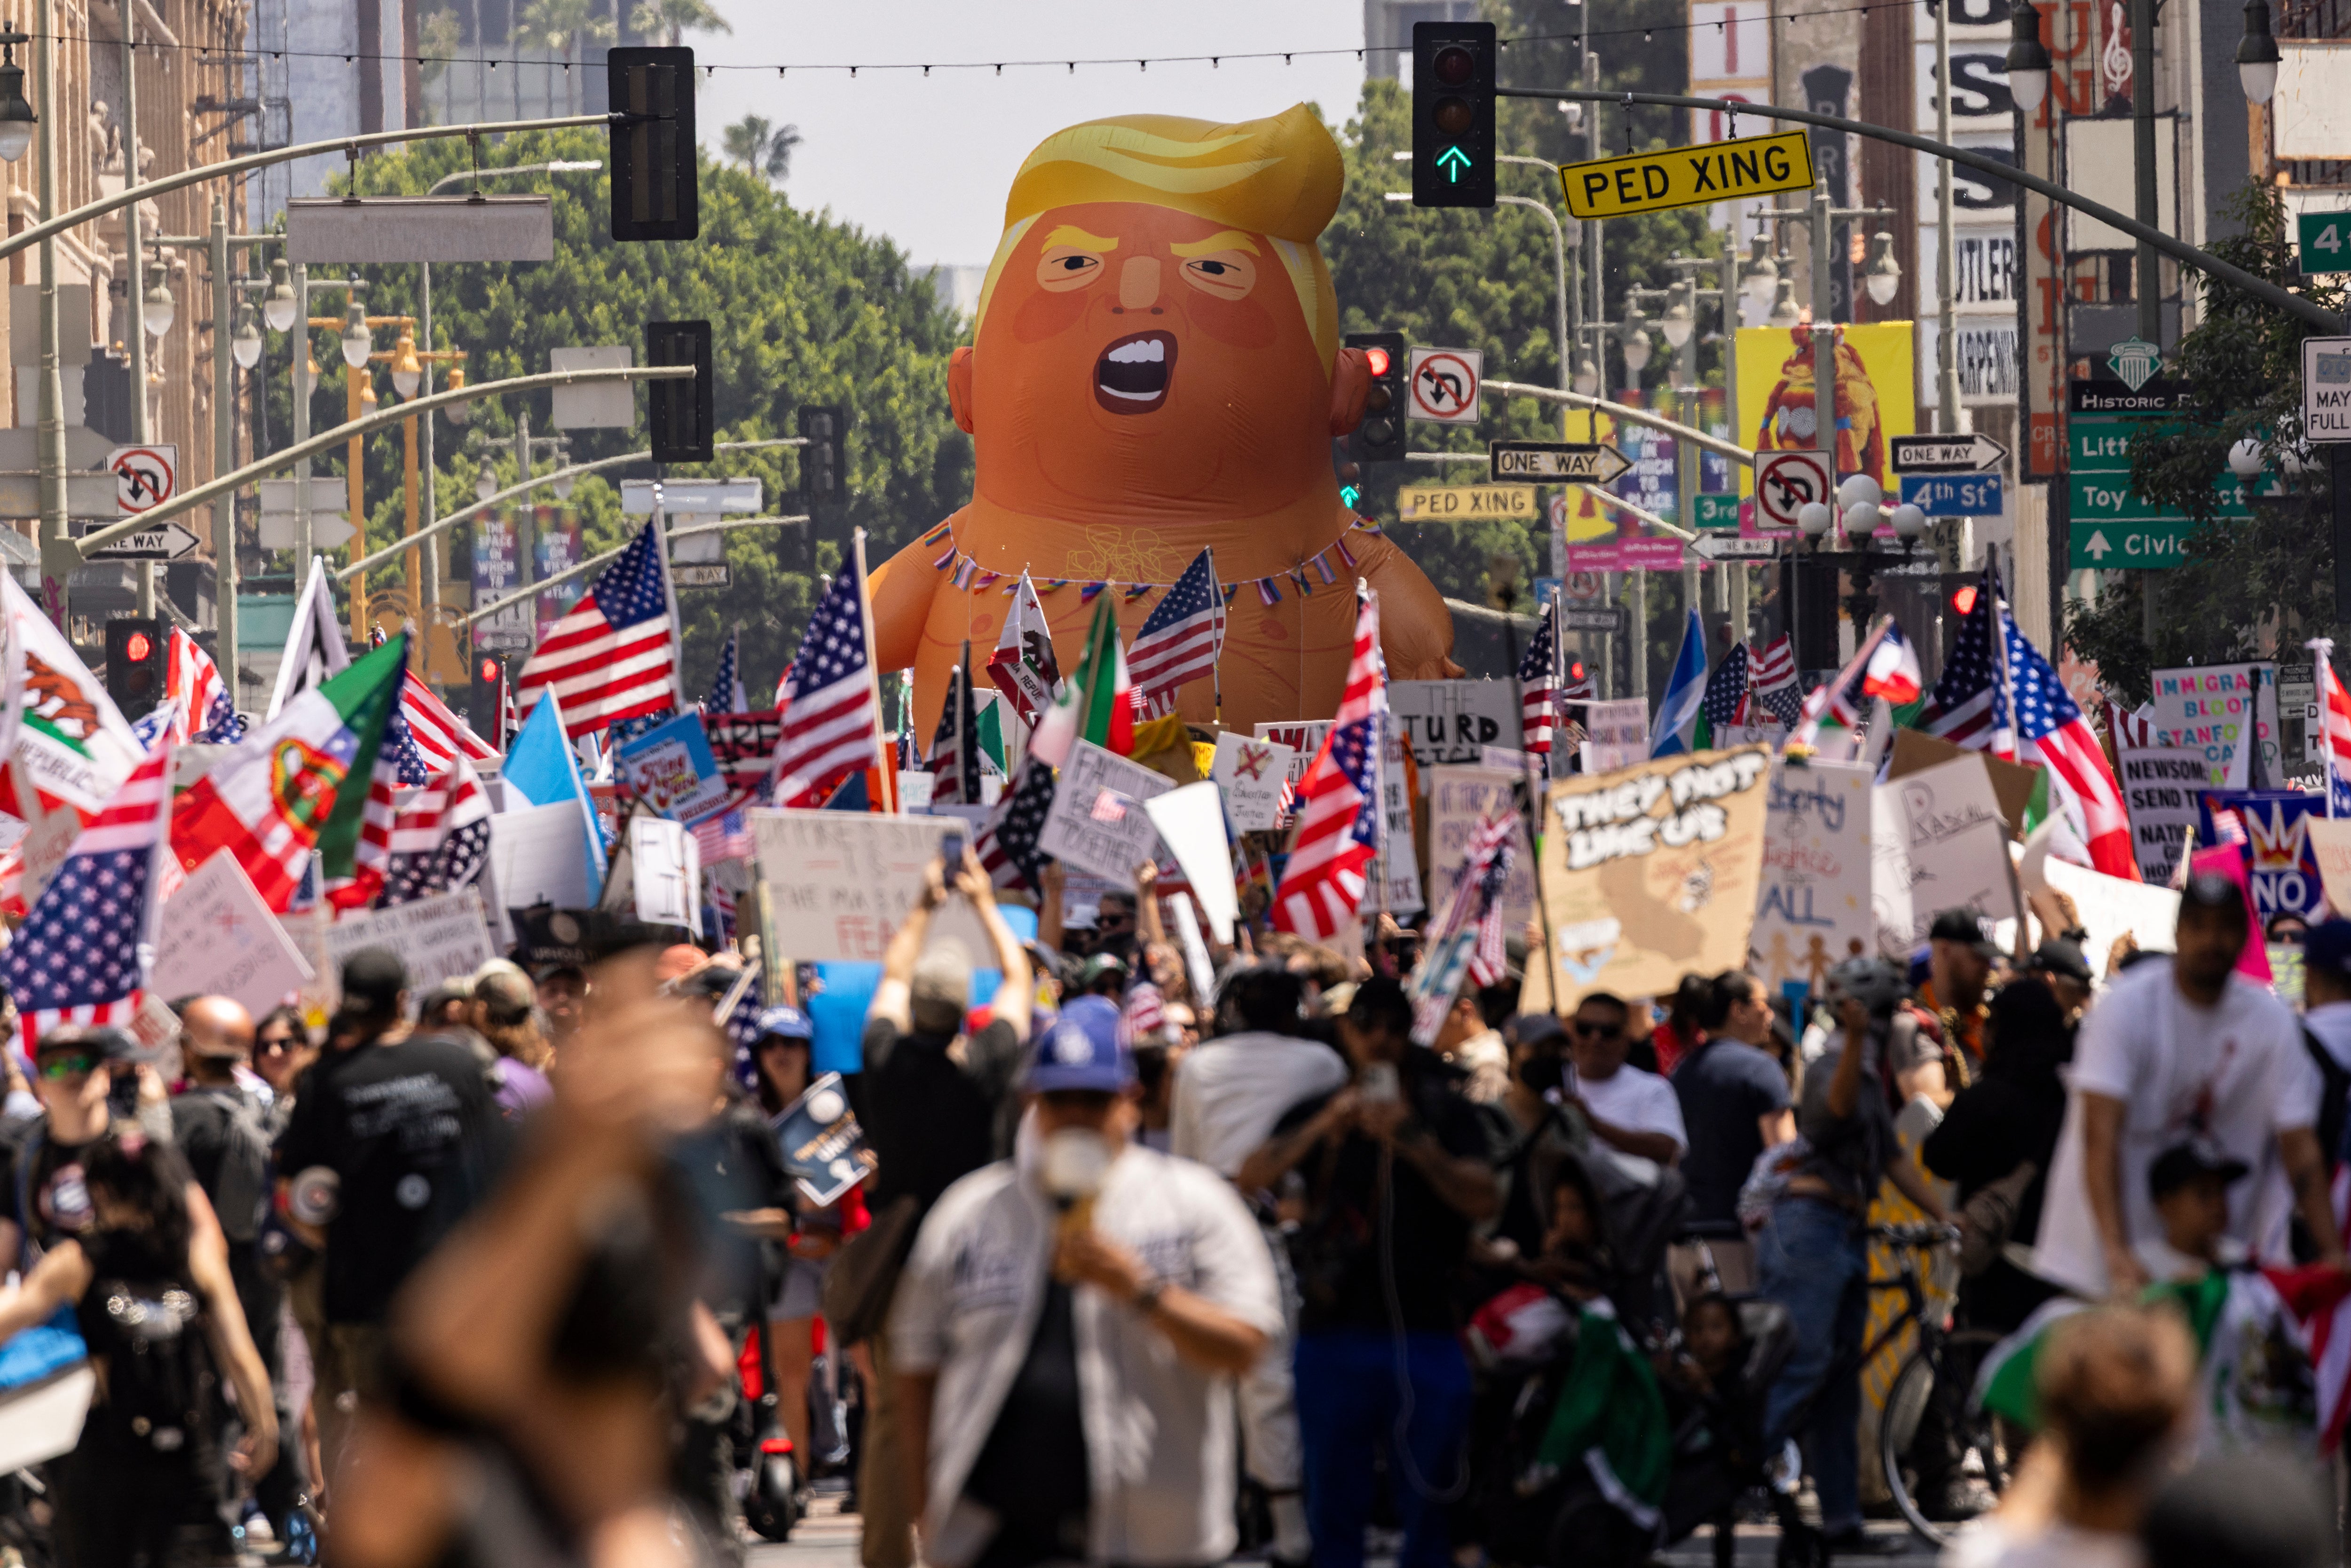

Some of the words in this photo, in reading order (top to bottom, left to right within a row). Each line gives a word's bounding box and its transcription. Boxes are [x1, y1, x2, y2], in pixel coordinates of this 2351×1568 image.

[1584, 165, 1669, 207] PED
[1689, 146, 1789, 193] XING
[2314, 224, 2351, 254] 4
[2317, 391, 2351, 408] MAY
[2311, 414, 2350, 430] FULL
[1903, 445, 1935, 462] ONE
[1941, 444, 1972, 461] WAY
[2082, 436, 2129, 457] Litt
[1501, 454, 1540, 471] ONE
[1556, 454, 1597, 472] WAY
[1639, 475, 1660, 492] TO
[1913, 481, 1954, 511] 4th
[1962, 481, 1988, 507] St
[1413, 492, 1458, 513] PED
[1470, 491, 1525, 512] XING
[1625, 491, 1674, 510] PLACE
[1702, 500, 1738, 520] 3rd
[2083, 487, 2127, 512] Toy
[134, 535, 165, 548] WAY
[477, 560, 515, 576] WHICH
[1419, 684, 1476, 715] THE
[1401, 713, 1499, 743] TURD
[2157, 722, 2269, 747] STANFOD
[637, 753, 687, 795] King
[655, 773, 698, 811] Taco
[1554, 774, 1667, 832] THEY
[1668, 750, 1766, 808] NOT
[2131, 788, 2181, 810] SEND
[1567, 816, 1659, 871] LIKE
[1659, 803, 1728, 846] US
[2251, 871, 2306, 912] NO
[1759, 882, 1837, 929] ALL
[835, 914, 897, 960] FEA
